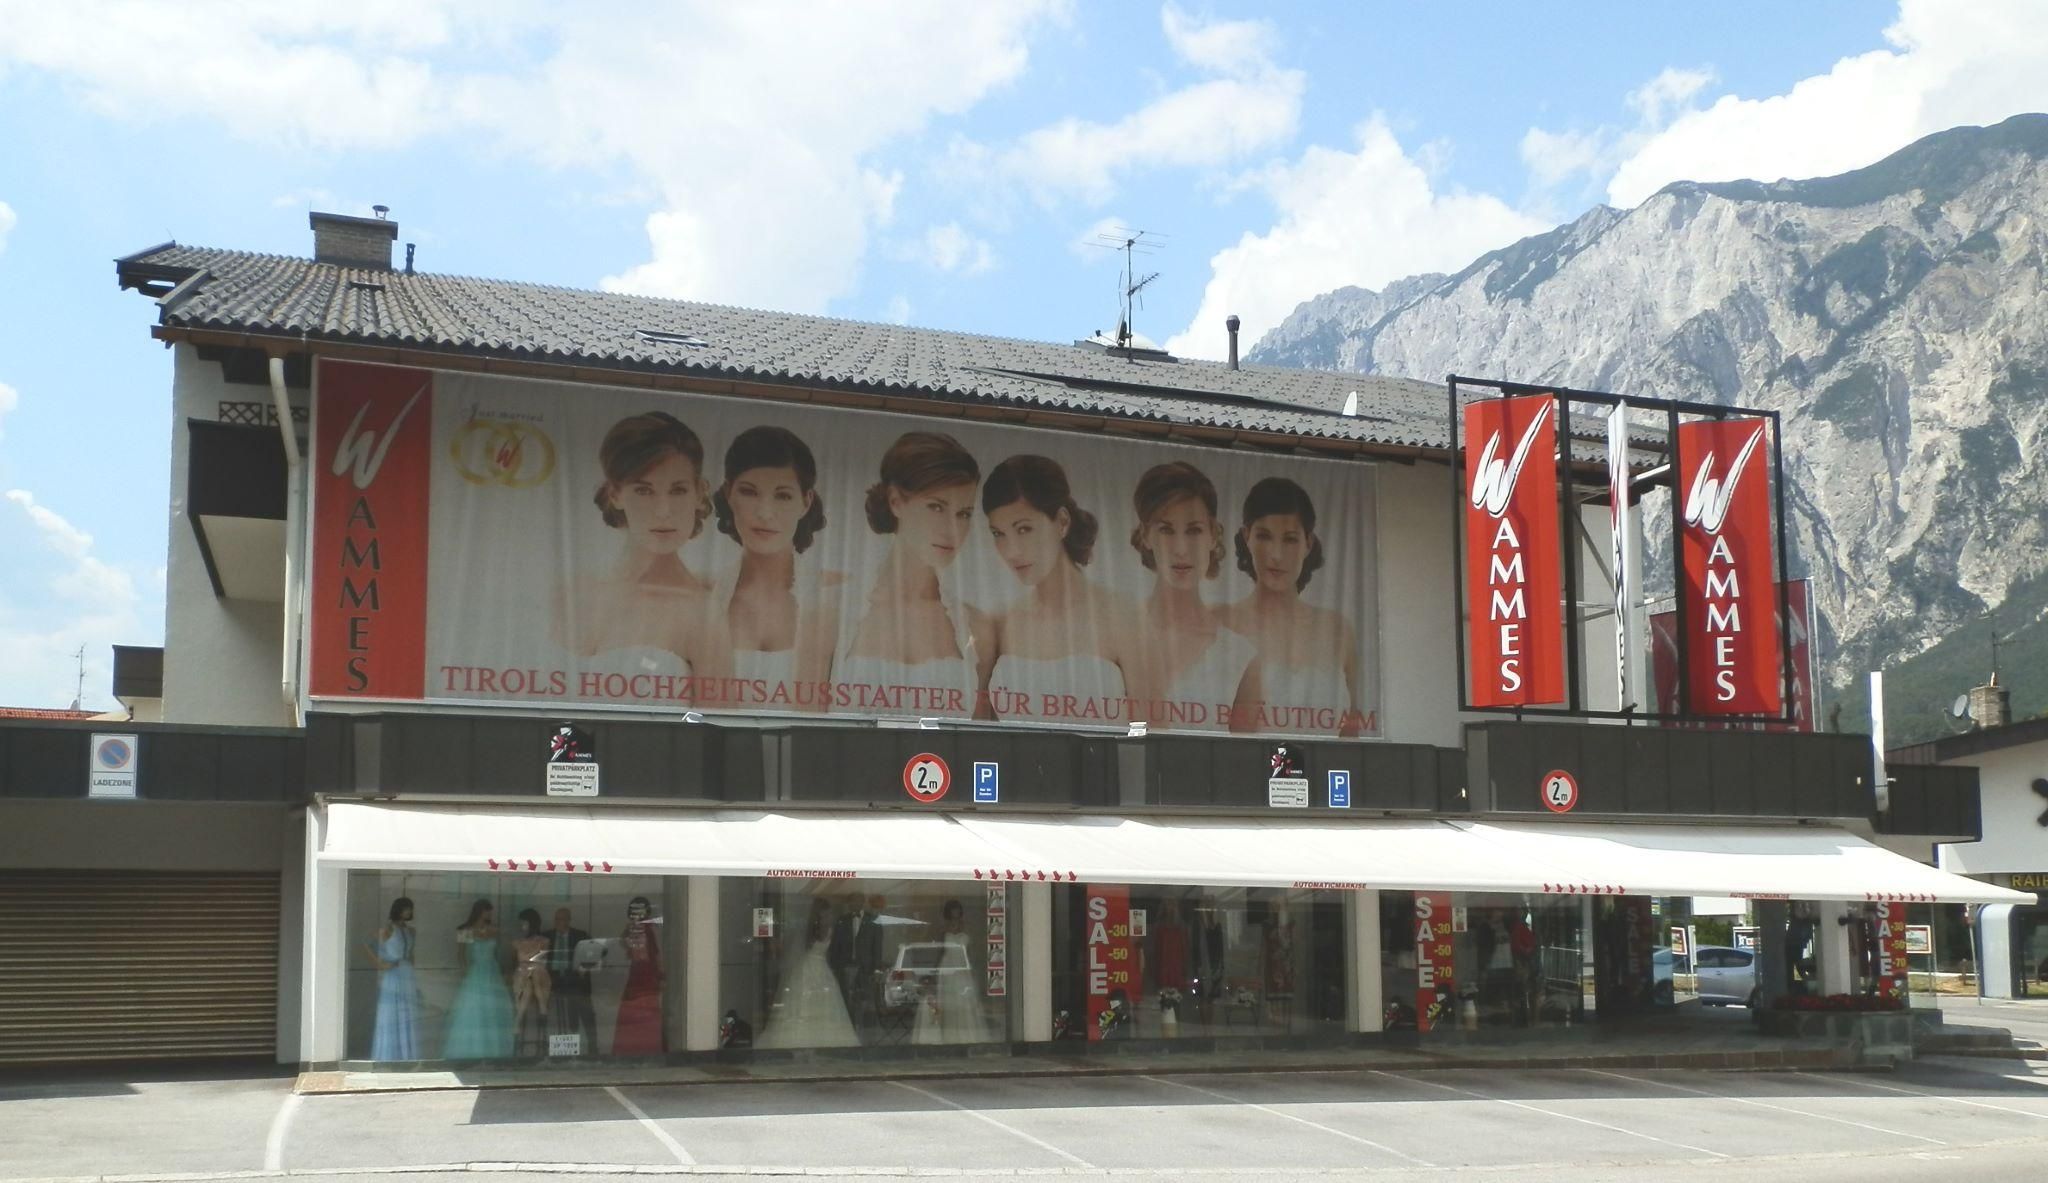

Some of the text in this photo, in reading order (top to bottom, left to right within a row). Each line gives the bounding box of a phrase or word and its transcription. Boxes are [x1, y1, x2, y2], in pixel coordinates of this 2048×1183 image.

[331, 379, 431, 692] WAMMES
[1471, 399, 1551, 692] WAMMES
[1684, 424, 1764, 702] WAMMES
[440, 666, 567, 696] TIROLS
[578, 672, 967, 712] HOCHZEITSAUSSTATTER
[1041, 693, 1141, 721] BRAUT
[1147, 699, 1207, 725] UND
[981, 768, 993, 783] P
[93, 779, 132, 787] LADEZONE
[1335, 775, 1345, 790] P
[766, 869, 857, 878] AUTOMATICMARKISE
[1293, 881, 1367, 889] AUTOMATICMARKISE
[1108, 925, 1128, 937] -30
[1433, 922, 1451, 934] -30
[1416, 896, 1435, 989] SALE
[1876, 900, 1893, 976] SALE
[1088, 896, 1110, 995] SALE
[1434, 944, 1452, 956] -50
[1108, 948, 1128, 960] -50
[1108, 971, 1129, 983] -70
[1434, 966, 1453, 978] -70
